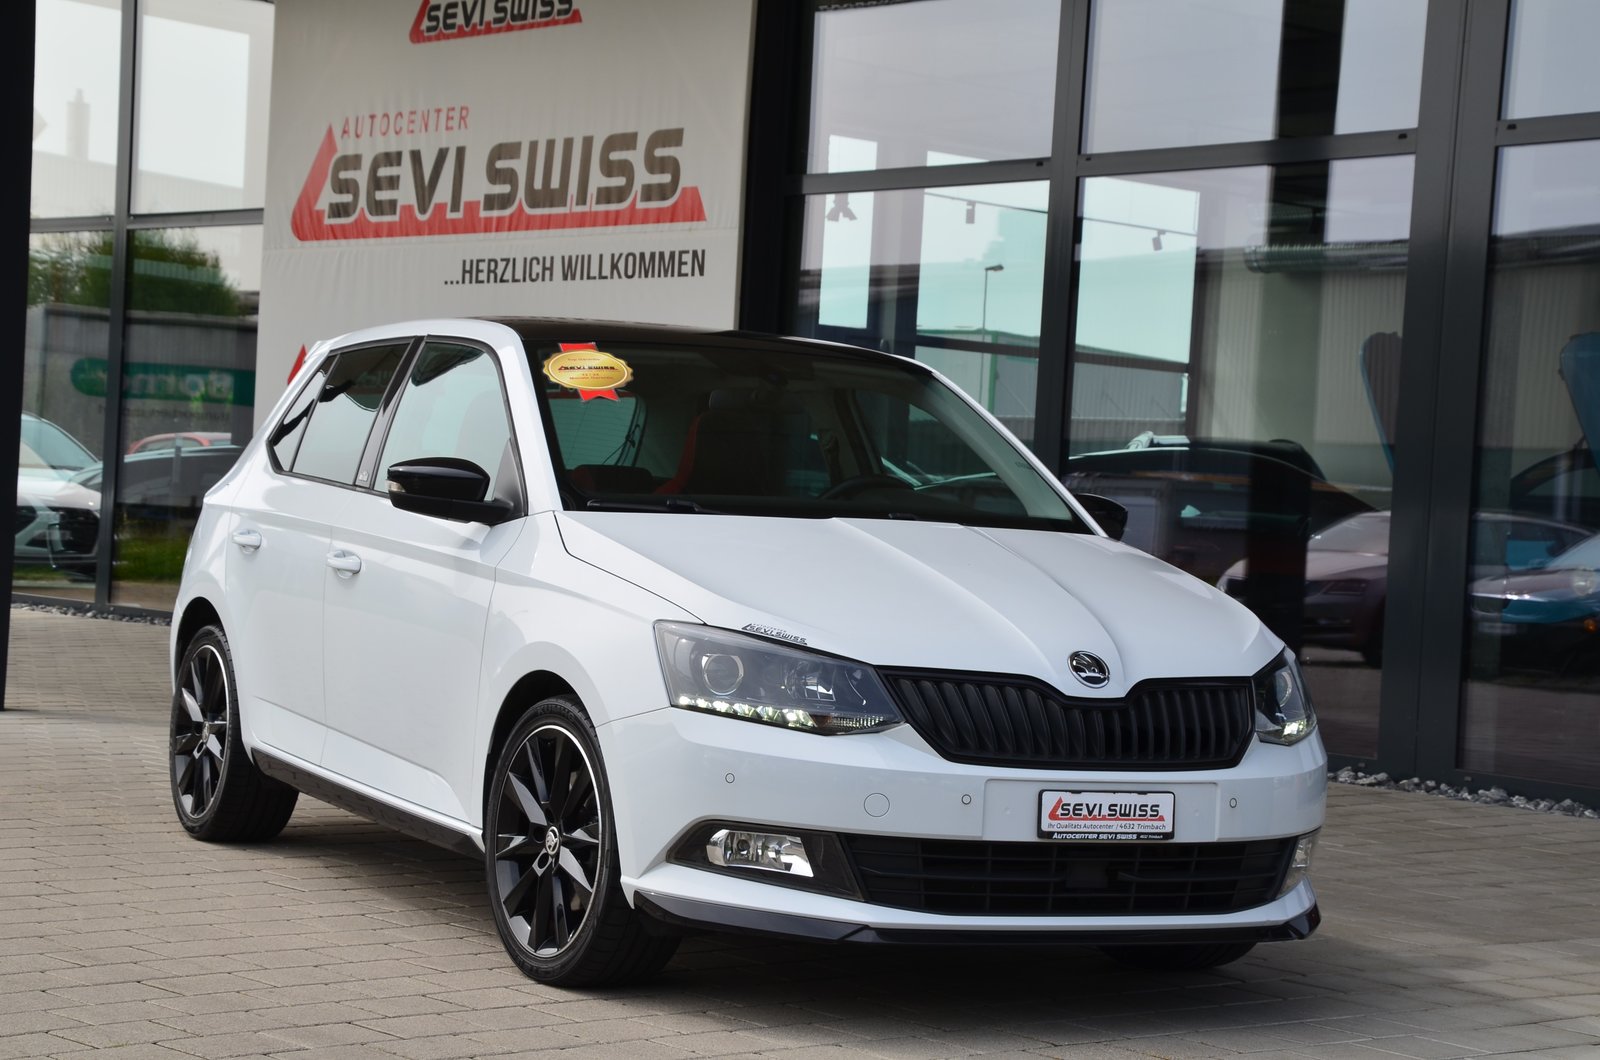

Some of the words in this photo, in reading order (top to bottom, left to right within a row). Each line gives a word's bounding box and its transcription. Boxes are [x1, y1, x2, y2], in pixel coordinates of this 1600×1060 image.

[426, 0, 486, 33] SEVI
[493, 0, 573, 25] SWISS
[341, 106, 469, 139] AUTOCENTER
[328, 146, 466, 219] SEVI
[482, 128, 684, 211] SWISS
[444, 256, 554, 285] ...HERZLICH
[561, 249, 706, 281] WILLKOMMEN
[750, 625, 773, 634] SEVI
[775, 631, 807, 643] SWISS
[1060, 803, 1102, 817] SEVI
[1107, 804, 1160, 818] SWISS
[1083, 822, 1114, 830] Autocenter
[1119, 822, 1135, 830] 4632
